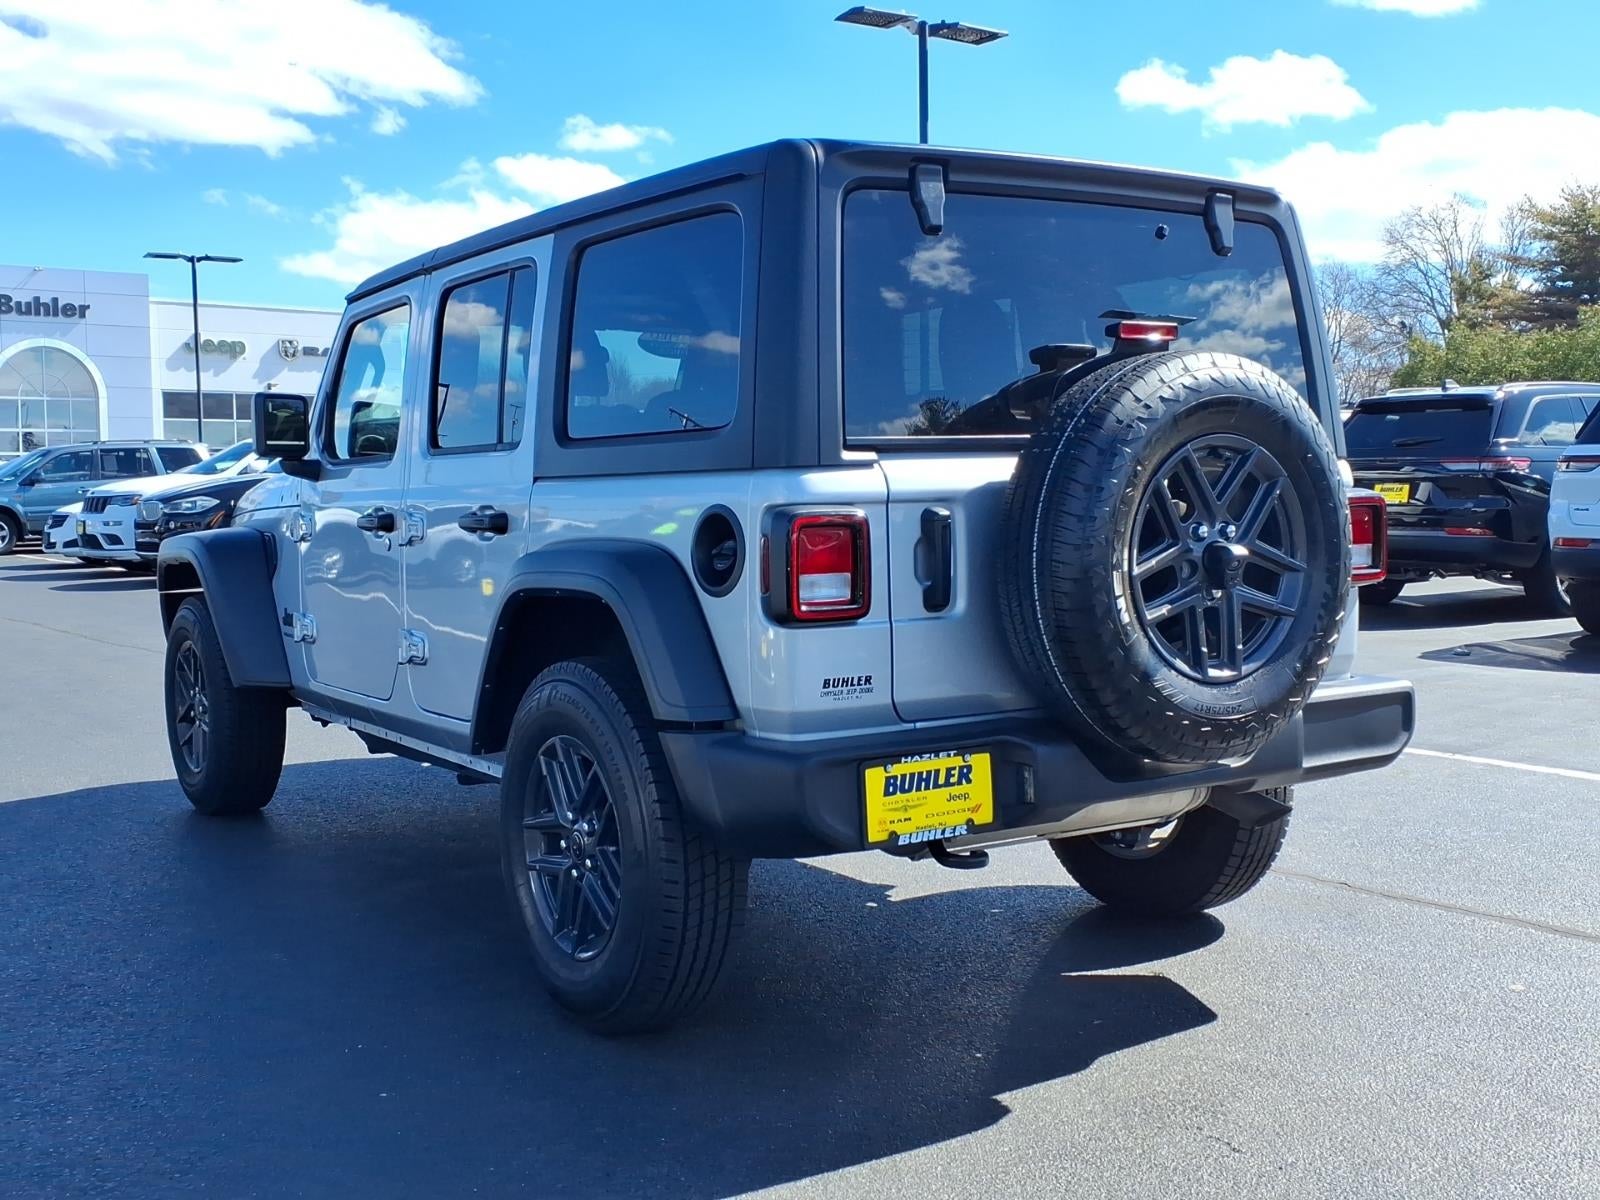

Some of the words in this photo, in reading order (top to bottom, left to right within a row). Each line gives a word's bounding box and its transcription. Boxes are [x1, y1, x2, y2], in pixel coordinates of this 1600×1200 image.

[0, 294, 90, 319] Buhler
[185, 331, 246, 360] Jeep
[303, 346, 330, 357] RA
[822, 675, 873, 689] BUHLER
[1194, 702, 1243, 714] 245/75R17
[901, 750, 957, 763] HAZLET
[883, 764, 973, 797] BUHLER
[882, 796, 927, 807] CHRYSLER
[946, 792, 970, 802] Jeep
[926, 807, 971, 819] DODGE
[889, 817, 912, 825] RAM
[898, 825, 967, 845] BUHLER
